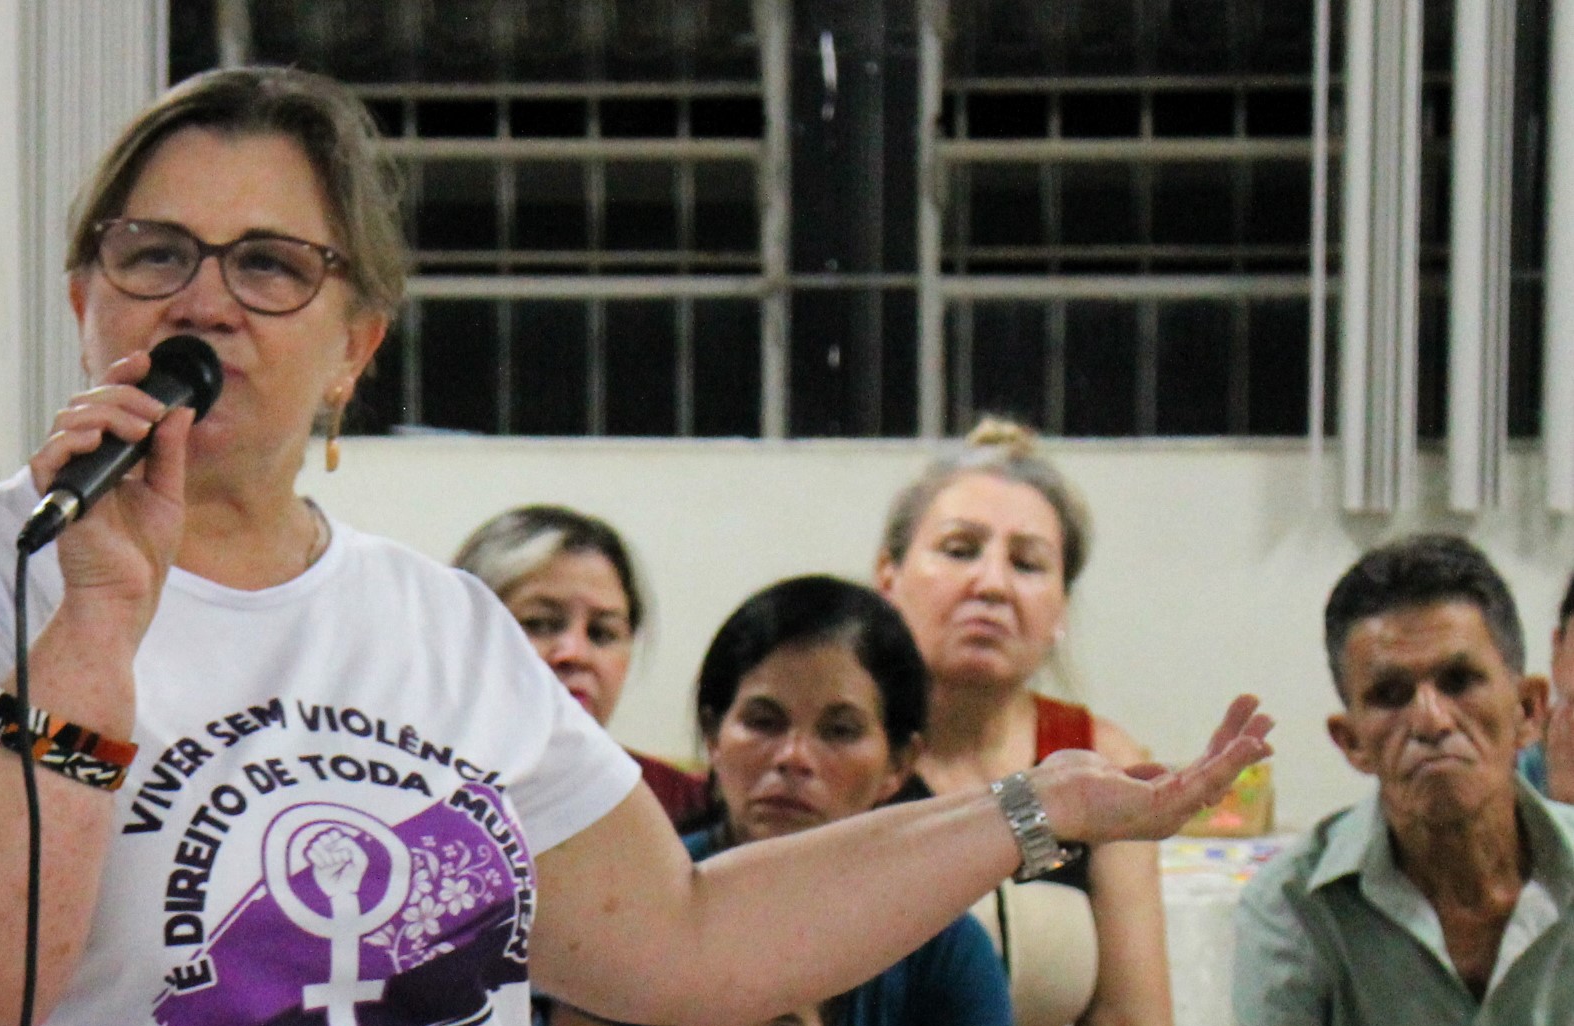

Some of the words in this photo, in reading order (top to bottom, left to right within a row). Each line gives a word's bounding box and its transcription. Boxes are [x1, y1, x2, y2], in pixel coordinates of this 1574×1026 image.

[122, 737, 214, 835] VIVER
[206, 697, 286, 747] SEM
[242, 758, 298, 795] DE
[299, 755, 434, 797] TODA
[164, 784, 247, 947] DIREITO
[164, 955, 212, 992] É
